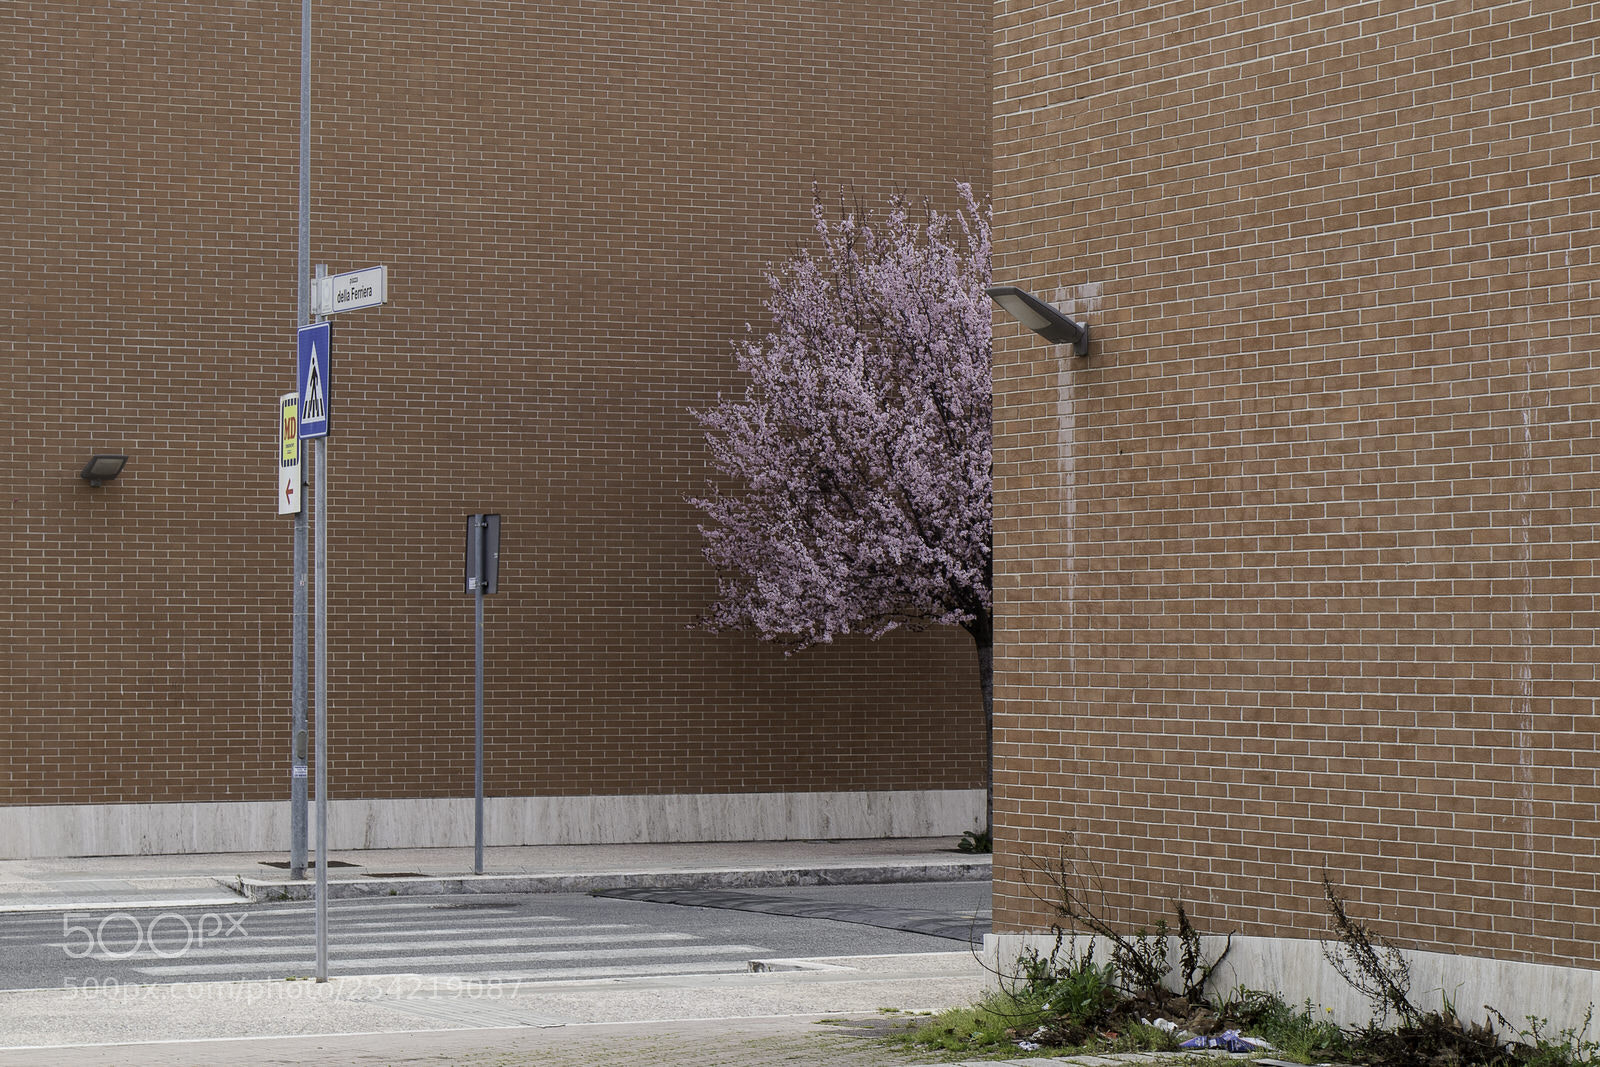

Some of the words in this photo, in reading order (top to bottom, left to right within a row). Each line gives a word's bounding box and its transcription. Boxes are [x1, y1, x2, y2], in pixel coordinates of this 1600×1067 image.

[337, 288, 350, 303] della
[351, 285, 373, 301] Ferriera
[284, 416, 296, 440] MD
